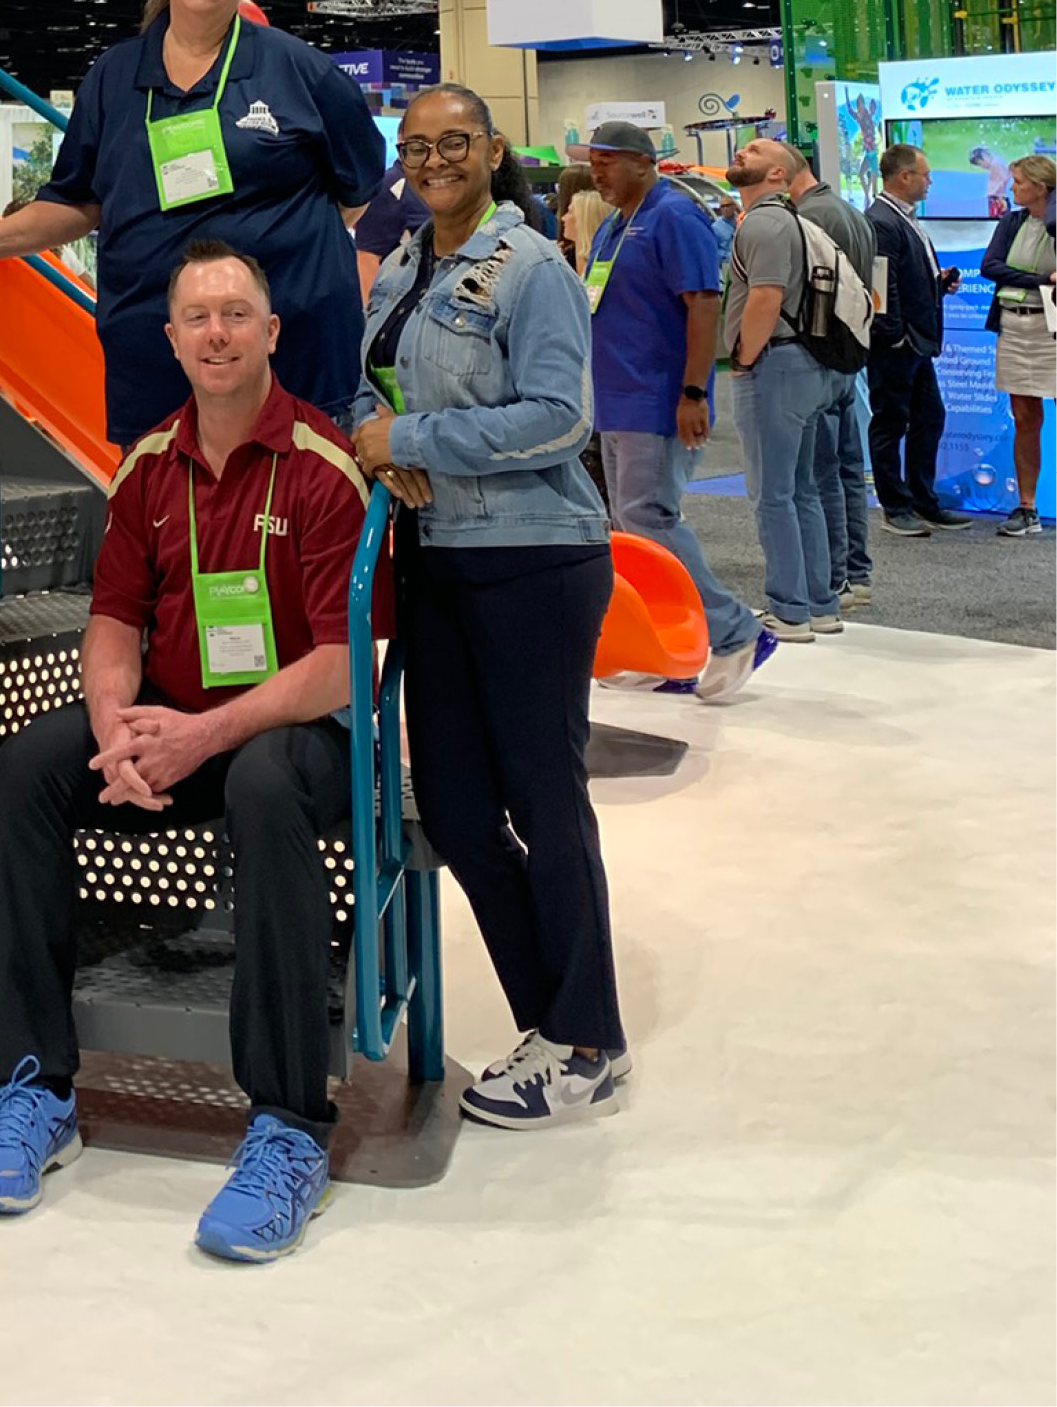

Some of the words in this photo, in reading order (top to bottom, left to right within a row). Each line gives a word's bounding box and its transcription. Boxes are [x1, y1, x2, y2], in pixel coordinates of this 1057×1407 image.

[944, 85, 990, 97] WATER
[993, 81, 1056, 94] ODYSSEY
[958, 283, 996, 294] ERIENC
[253, 513, 288, 537] FSU
